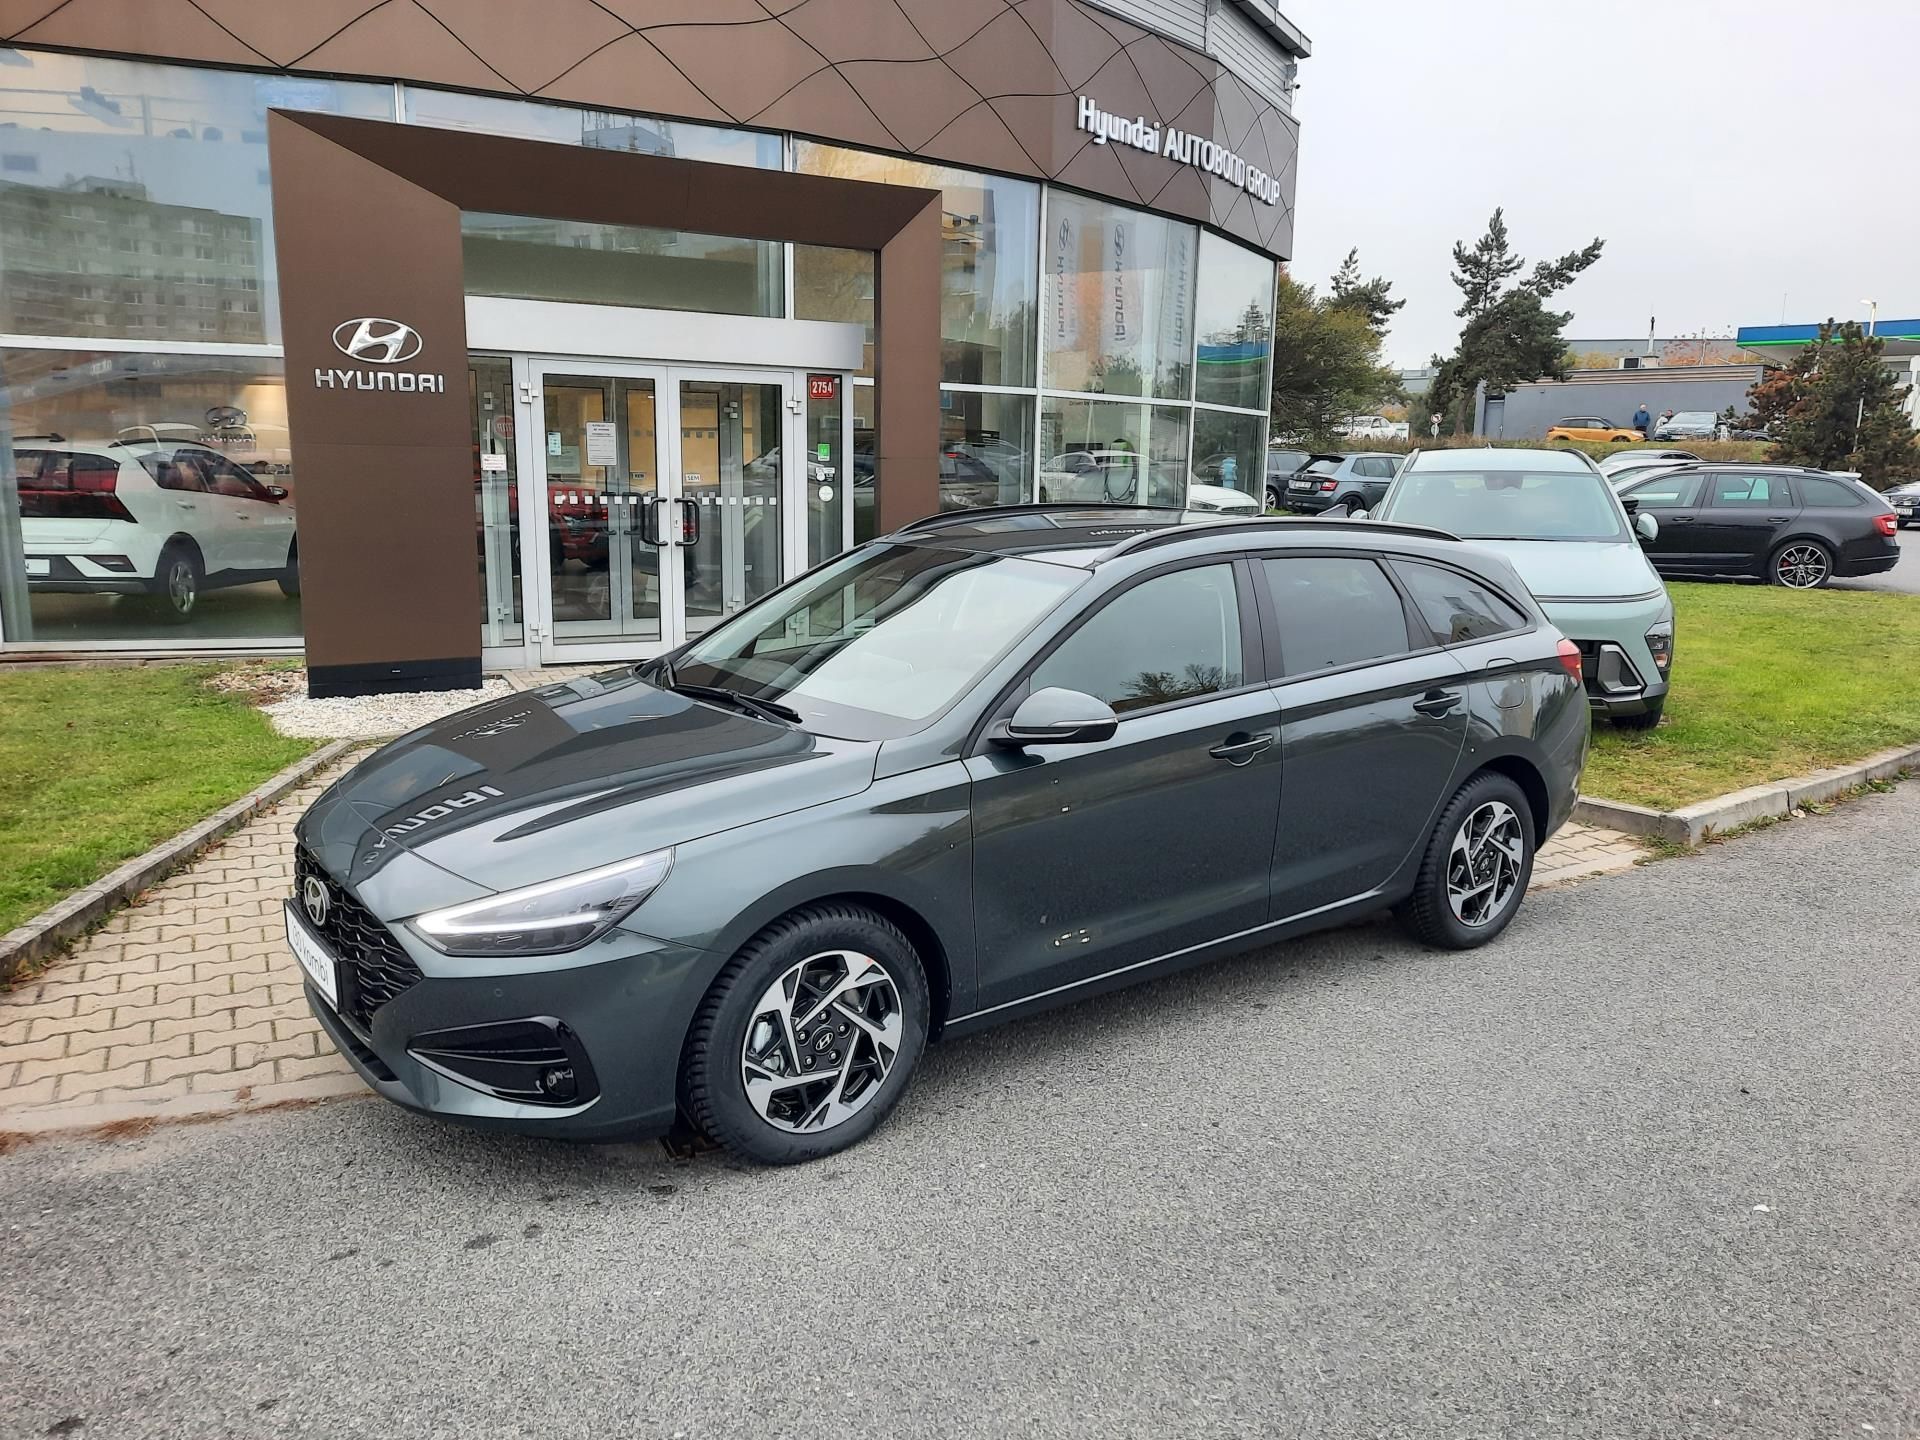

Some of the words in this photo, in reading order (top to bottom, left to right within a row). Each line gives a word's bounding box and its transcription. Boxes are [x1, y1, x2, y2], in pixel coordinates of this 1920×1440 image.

[1077, 95, 1161, 154] Hyundai
[1162, 127, 1247, 188] AUTOBOND
[1245, 164, 1281, 206] GROUP
[1057, 256, 1065, 338] HYUNDAI
[1114, 261, 1126, 341] HYUNDAI
[1173, 270, 1187, 348] HYUNDAI
[314, 368, 444, 393] HYUNDAI
[812, 381, 833, 394] 2754
